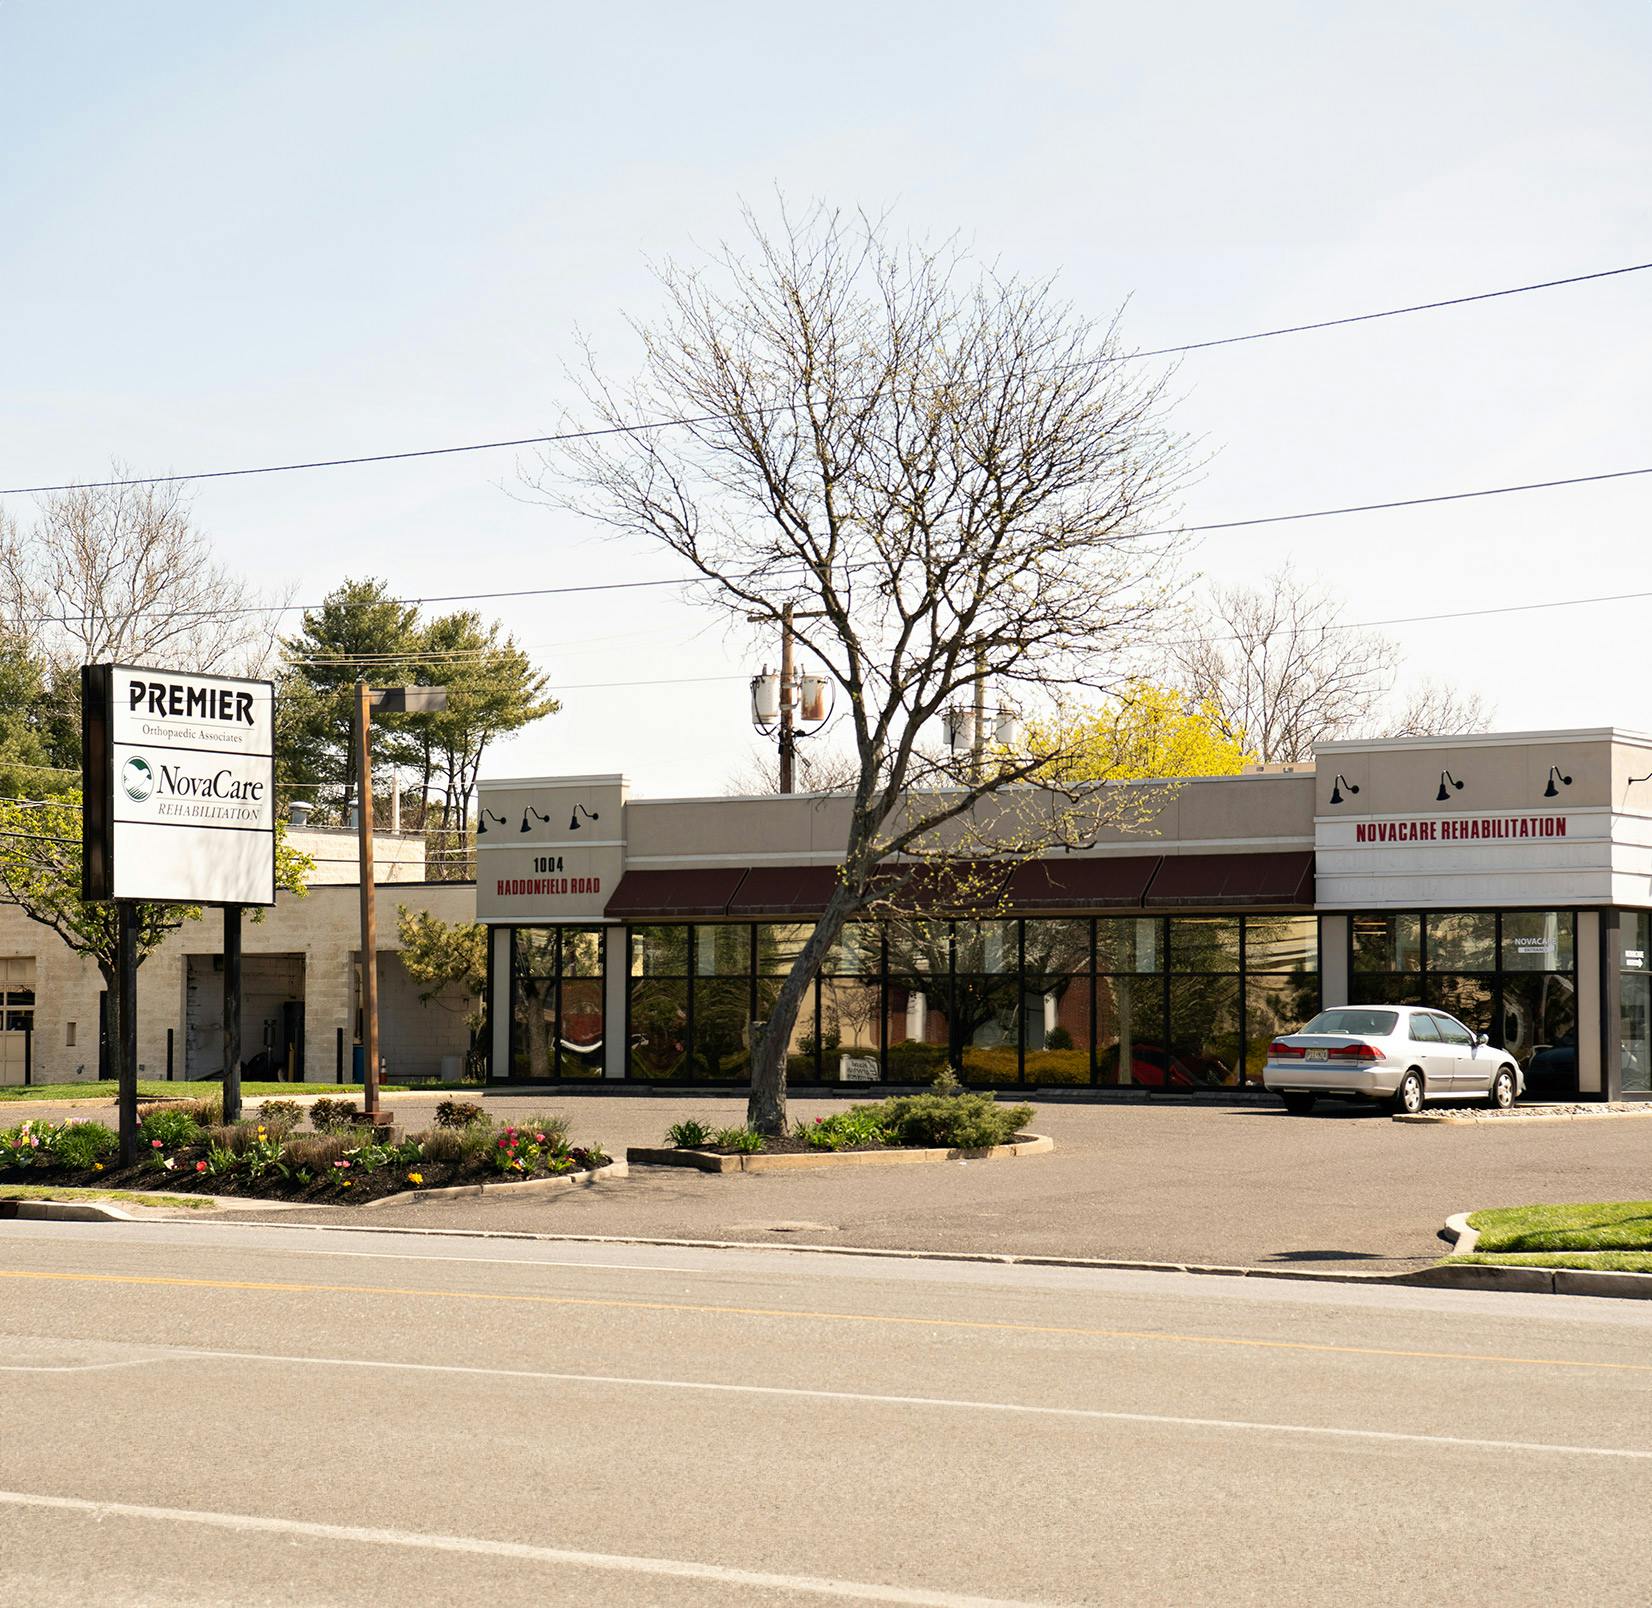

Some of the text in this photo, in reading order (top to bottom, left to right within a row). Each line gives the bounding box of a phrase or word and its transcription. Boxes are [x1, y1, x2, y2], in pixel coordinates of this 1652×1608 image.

[129, 680, 255, 726] PREMIER
[142, 724, 243, 743] Orthopaedic Associates
[156, 765, 264, 801] NovaCare
[158, 803, 260, 820] REHABILITATION
[1356, 817, 1567, 843] NOVACARE REHABILITATION
[534, 857, 563, 872] 1004
[497, 878, 600, 895] HADDONFIELD ROAD
